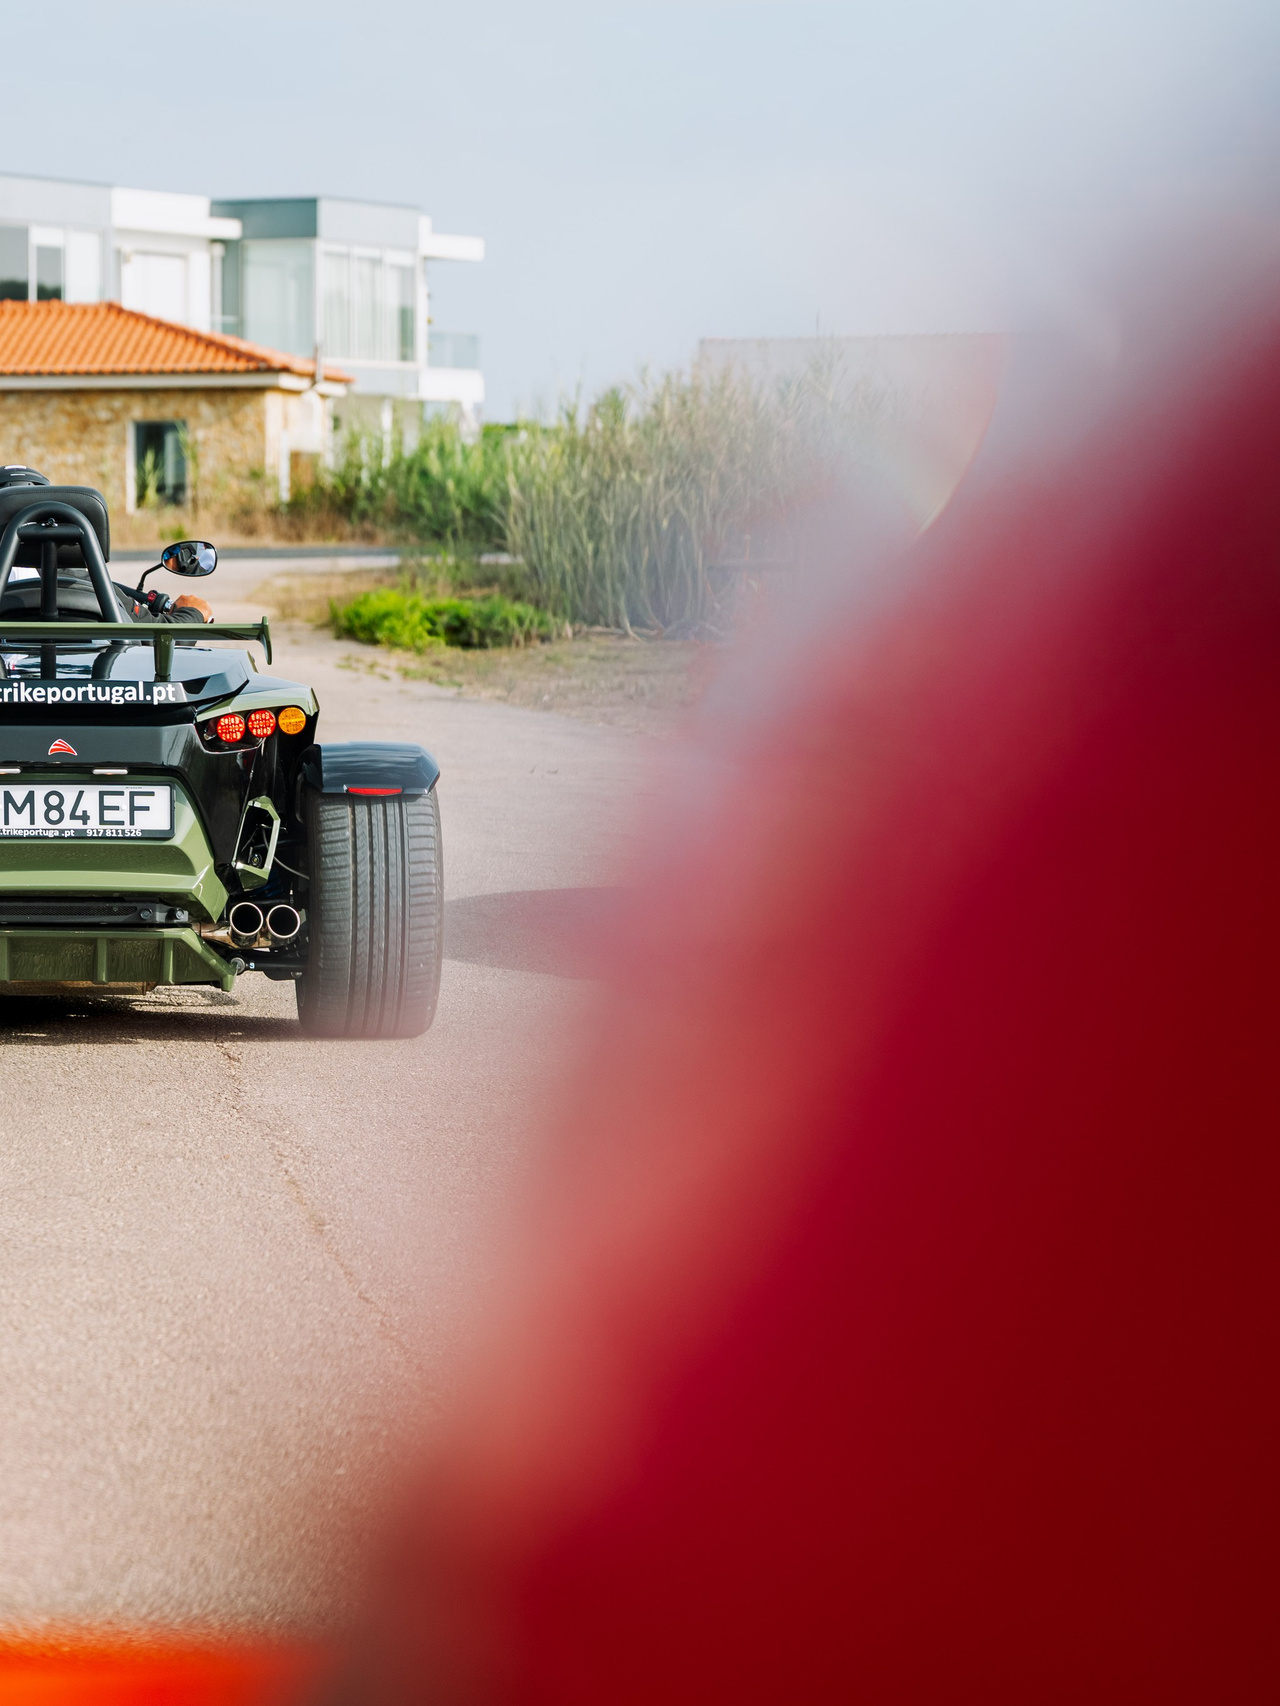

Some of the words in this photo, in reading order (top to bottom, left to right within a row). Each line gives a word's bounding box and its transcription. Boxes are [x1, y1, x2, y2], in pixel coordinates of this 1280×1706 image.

[86, 829, 103, 837] 917
[105, 829, 122, 837] 811
[124, 829, 142, 837] 526
